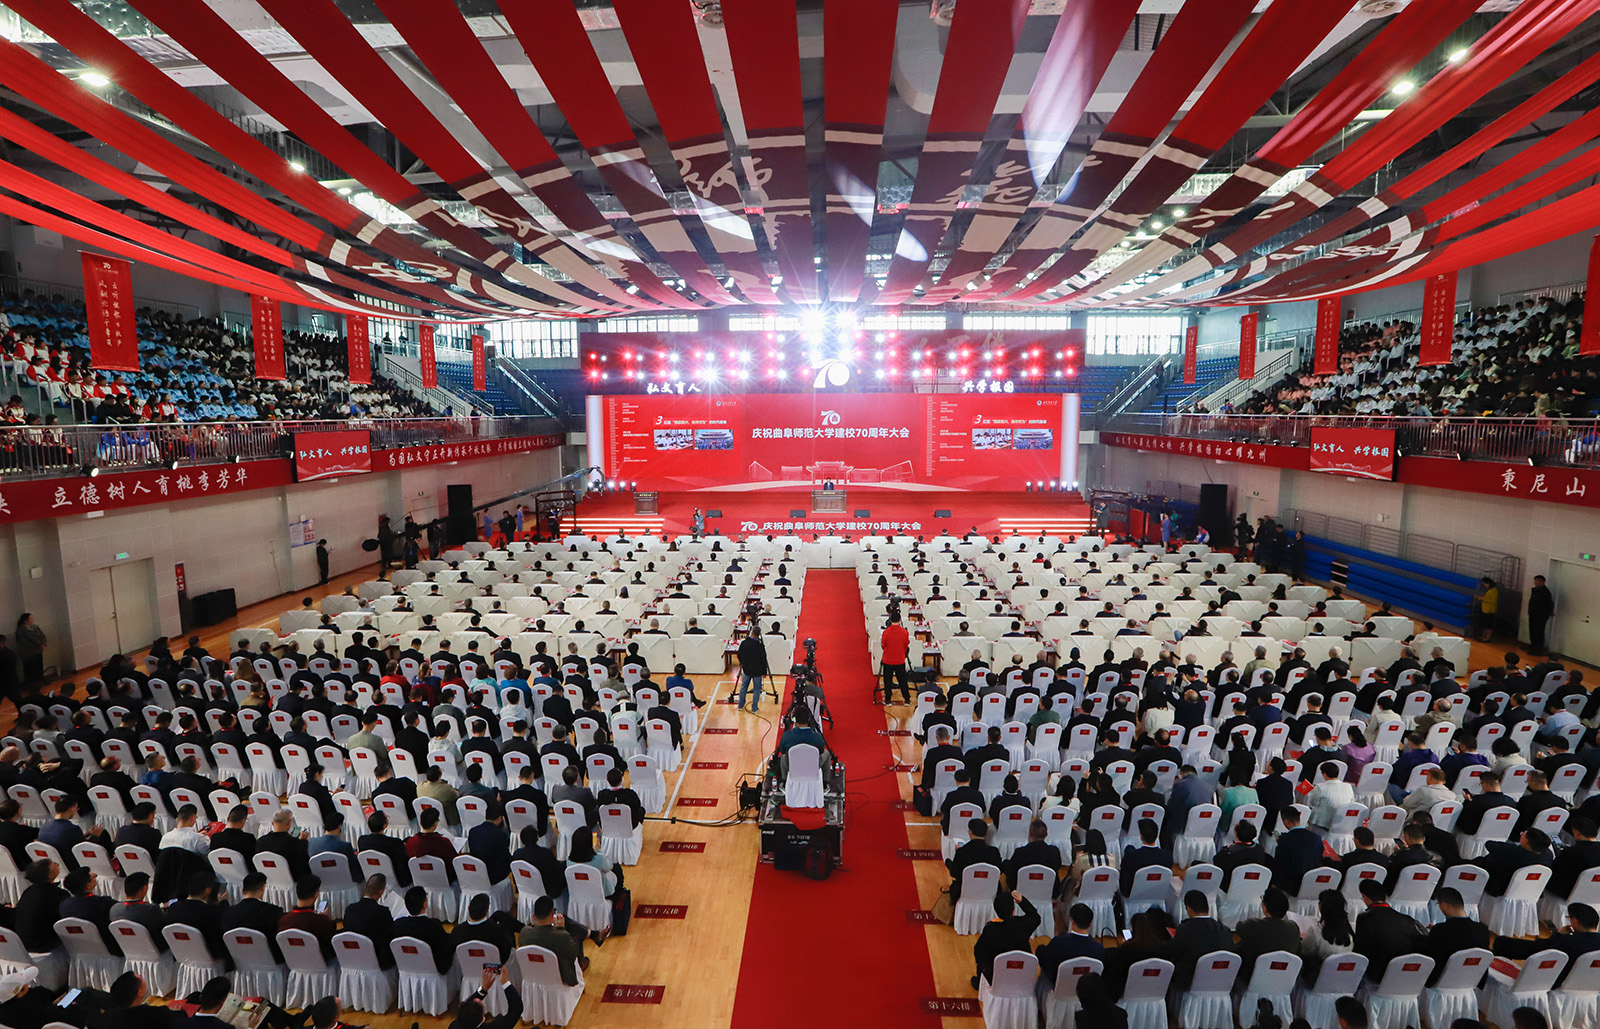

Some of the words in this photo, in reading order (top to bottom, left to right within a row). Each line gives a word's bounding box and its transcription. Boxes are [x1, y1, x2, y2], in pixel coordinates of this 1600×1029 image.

[811, 358, 850, 388] 70
[646, 381, 701, 395] 弘文育人
[751, 427, 910, 439] 庆祝曲阜师范大学建校70周年大会
[299, 448, 333, 460] 弘文育人
[1313, 443, 1345, 453] 弘文育人
[51, 467, 249, 509] 立德树人育桃李芳华
[1501, 468, 1586, 497] 秉尼山
[762, 521, 922, 531] 庆祝曲阜师范大学建校70周年大会
[613, 988, 655, 998] 第十六排
[928, 1001, 970, 1011] 第十六排
